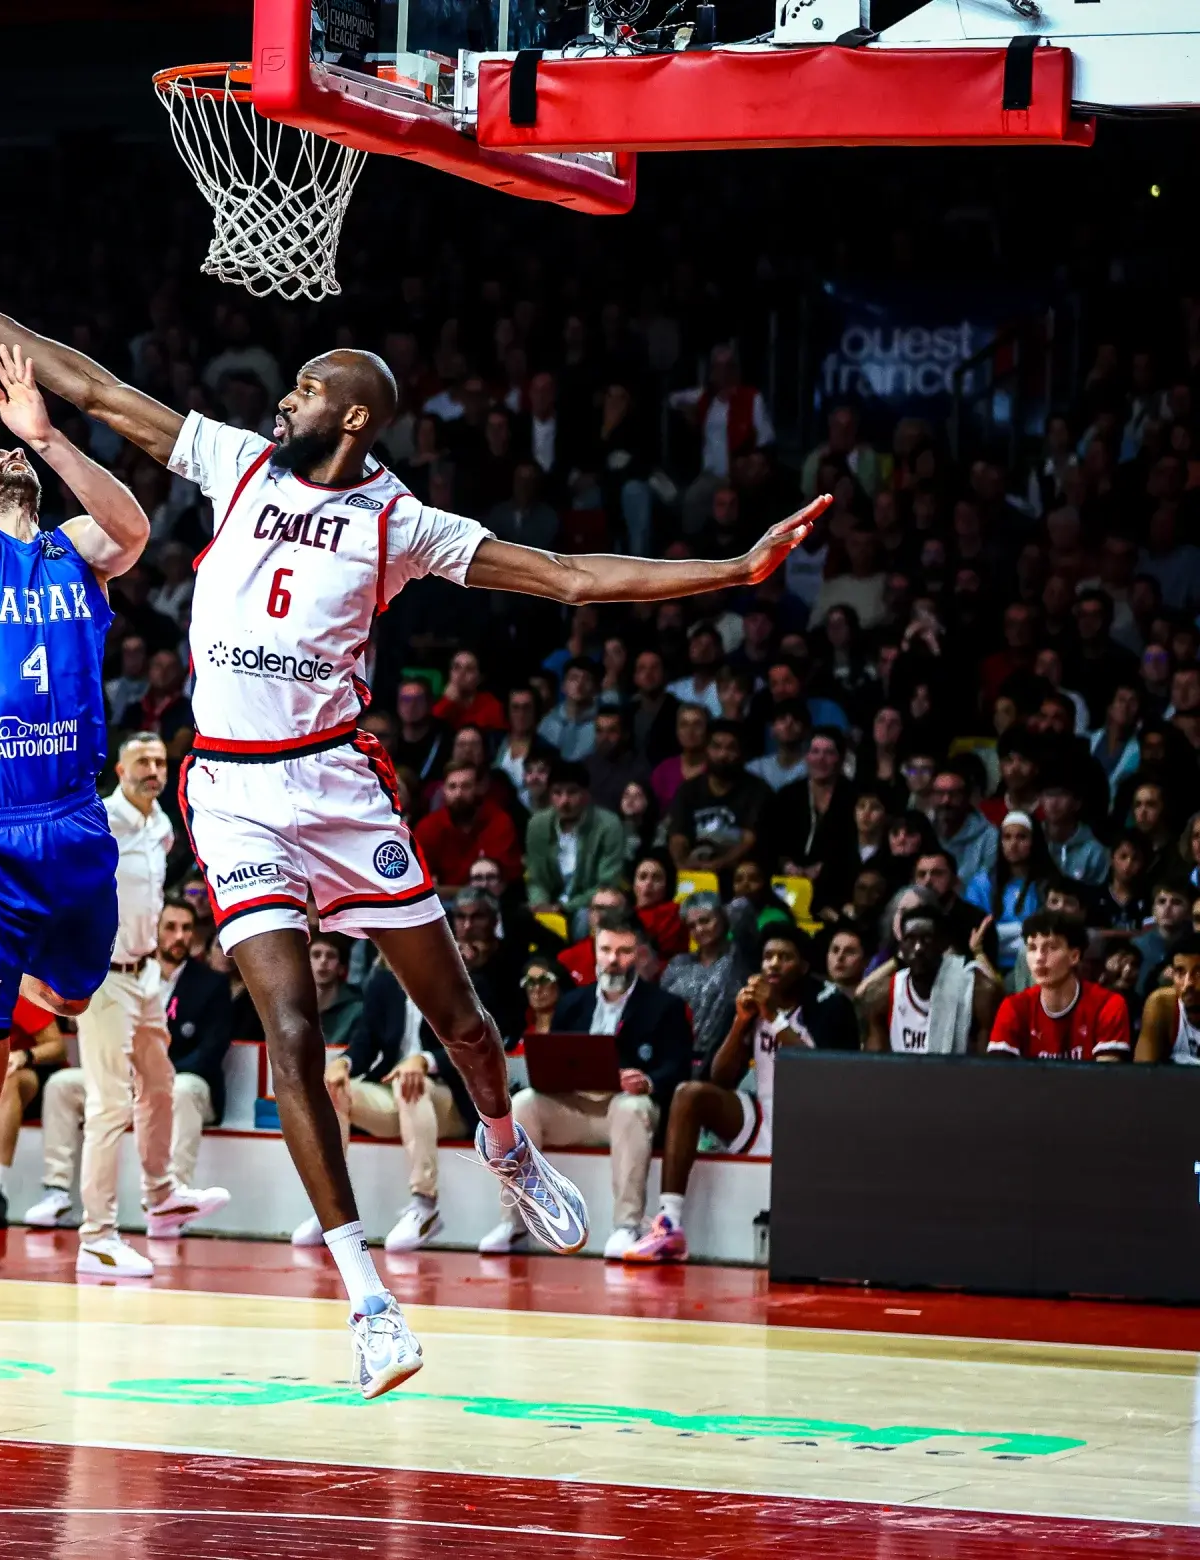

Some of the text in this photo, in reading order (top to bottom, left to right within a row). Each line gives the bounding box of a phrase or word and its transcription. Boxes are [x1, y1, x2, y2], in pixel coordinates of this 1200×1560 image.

[329, 25, 361, 51] LEAGUE
[330, 8, 375, 39] CHAMPIONS
[840, 319, 973, 361] ouest
[253, 503, 350, 553] CHOLET
[266, 567, 294, 619] 6
[20, 642, 49, 695] 4
[231, 645, 334, 683] solengie
